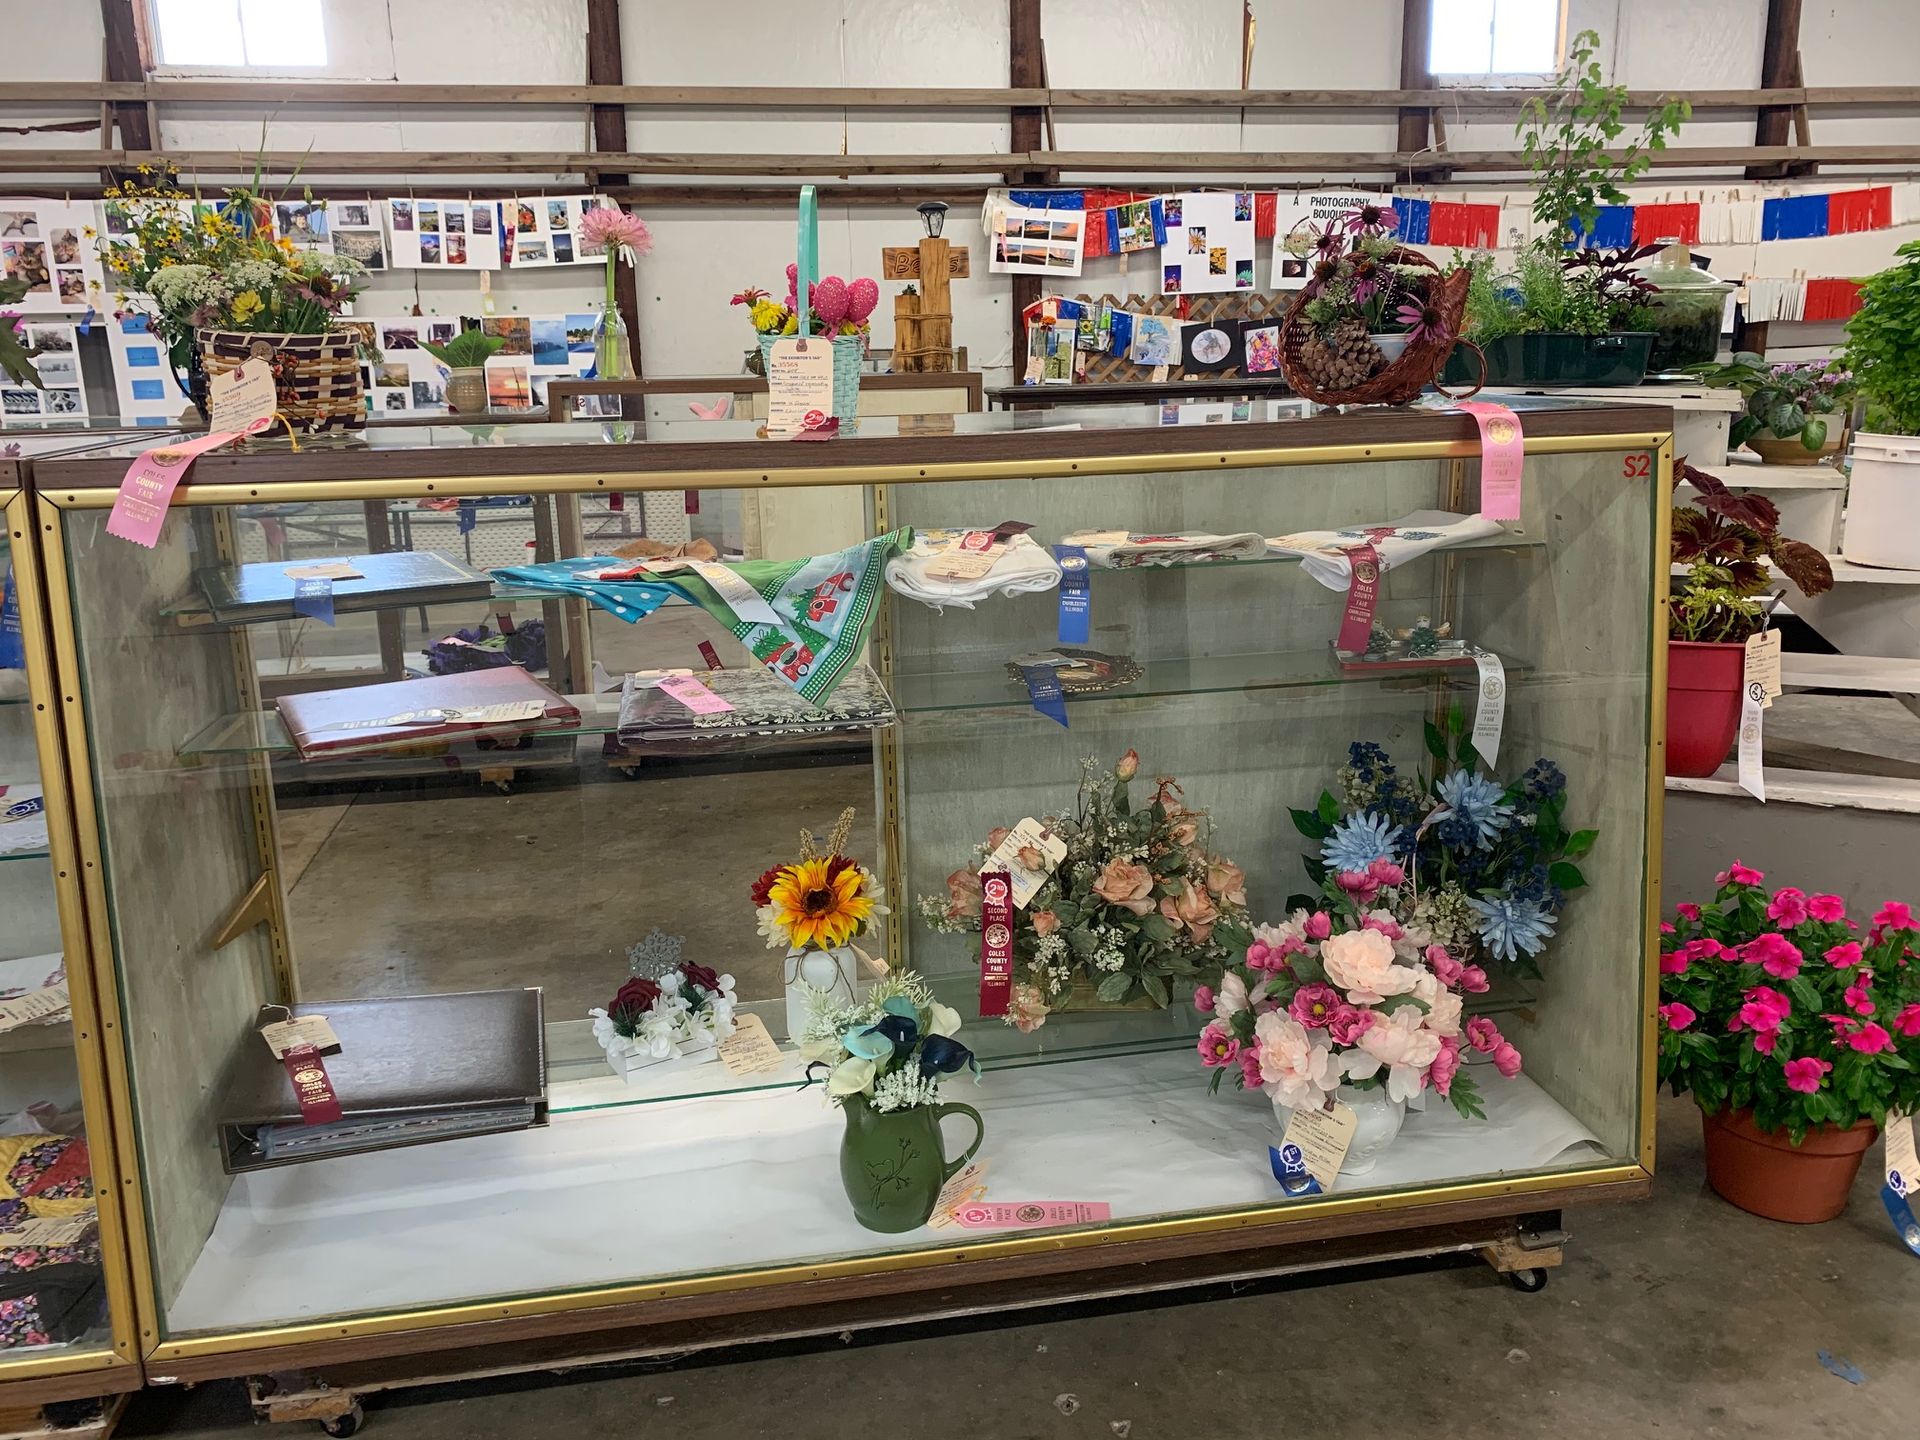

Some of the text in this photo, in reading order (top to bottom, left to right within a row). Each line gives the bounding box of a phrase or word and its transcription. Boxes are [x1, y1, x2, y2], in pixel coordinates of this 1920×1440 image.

[1293, 196, 1371, 207] A PHOTOGRAPHY
[1313, 209, 1349, 220] BOUQU
[1623, 454, 1651, 478] S2
[135, 476, 164, 492] COUNTY
[137, 488, 154, 500] FAIR
[1357, 584, 1373, 593] COLES
[1353, 591, 1374, 601] COUNTY
[1355, 599, 1368, 607] FAIR
[1483, 715, 1495, 723] FAIR
[989, 883, 1004, 895] 2ND
[987, 907, 1009, 915] SECOND
[989, 914, 1006, 922] PLACE
[986, 957, 1008, 965] COUNTY
[301, 1084, 327, 1092] COUNTY
[1284, 1147, 1298, 1162] 1ST
